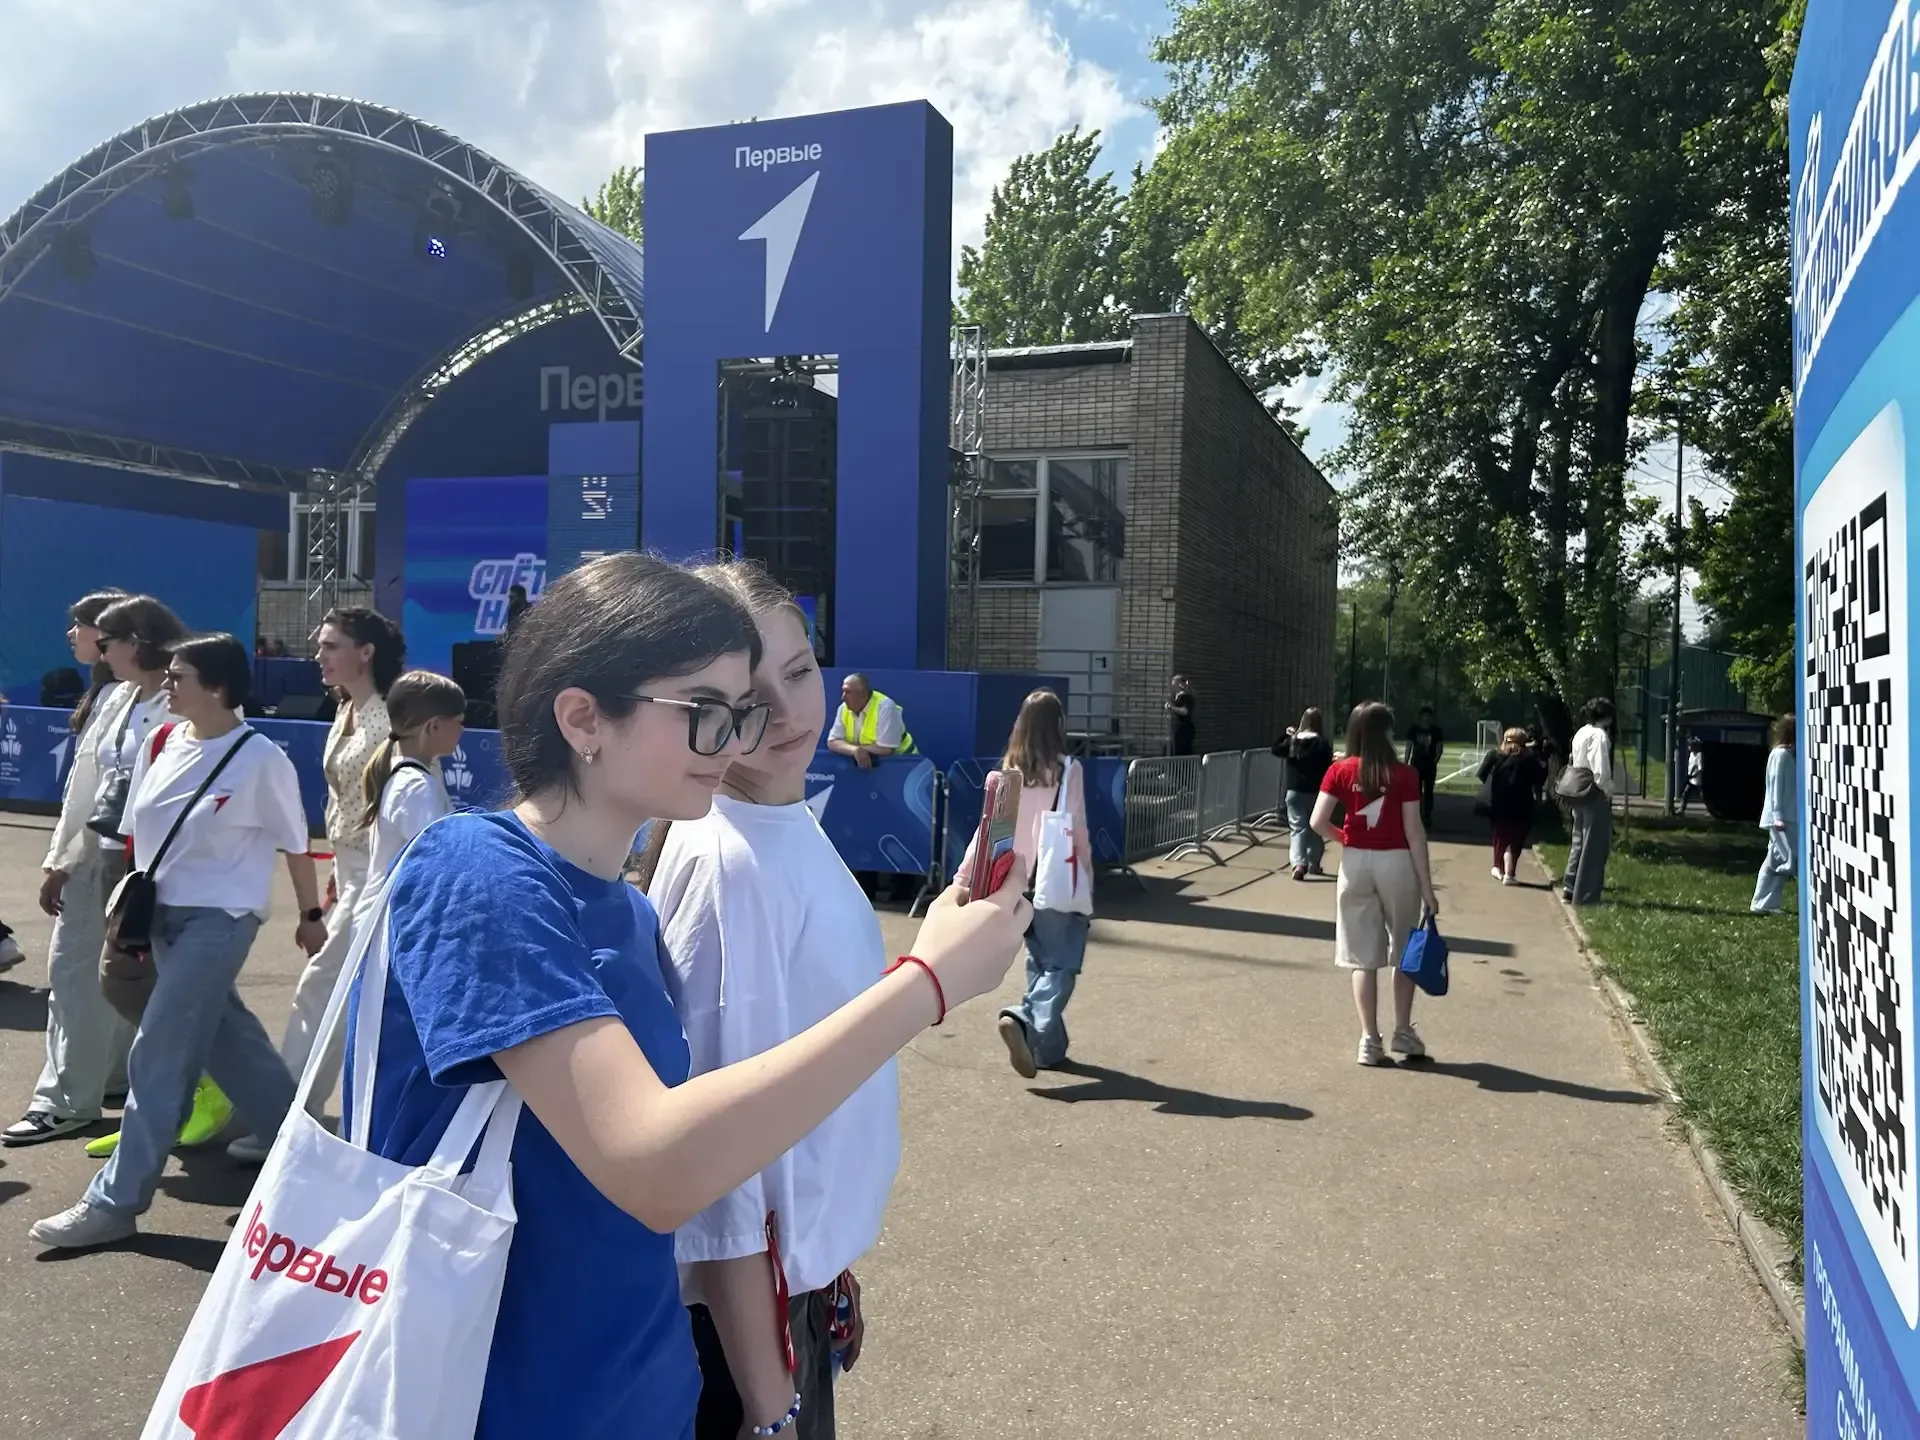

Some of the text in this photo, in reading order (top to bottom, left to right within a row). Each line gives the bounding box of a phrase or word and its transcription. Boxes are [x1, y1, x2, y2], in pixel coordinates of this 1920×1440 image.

[735, 143, 822, 172] Первые
[805, 772, 835, 783] ервые
[1813, 1239, 1865, 1433] ПРОГРАММА
